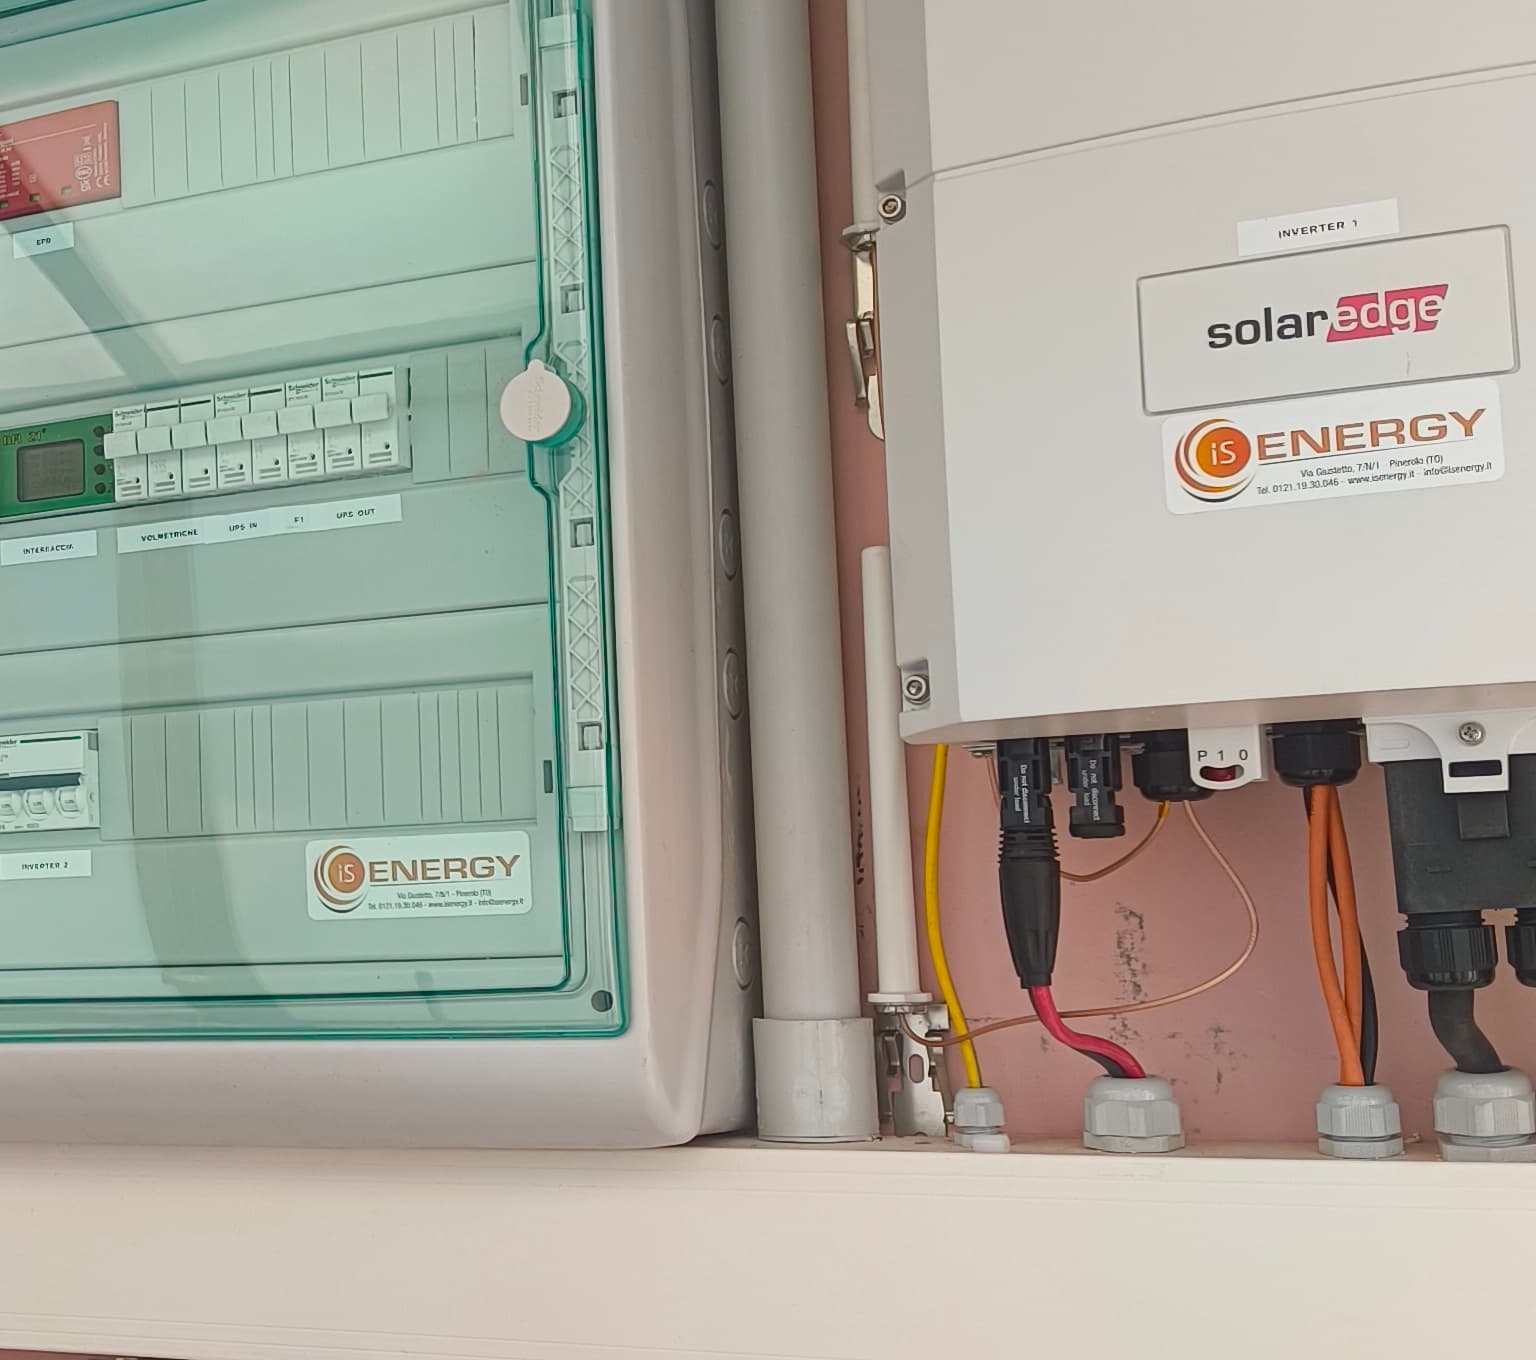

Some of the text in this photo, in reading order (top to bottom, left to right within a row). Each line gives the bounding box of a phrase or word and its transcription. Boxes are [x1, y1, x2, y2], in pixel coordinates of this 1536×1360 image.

[1278, 220, 1345, 239] INVERTER
[1207, 288, 1445, 349] solaredge
[1257, 408, 1486, 461] ENERGY
[1300, 468, 1314, 478] Via
[1425, 454, 1444, 465] (TO)
[357, 508, 376, 517] OUT
[1197, 750, 1208, 761] P
[21, 862, 61, 871] INVERTER
[368, 854, 521, 883] ENERGY
